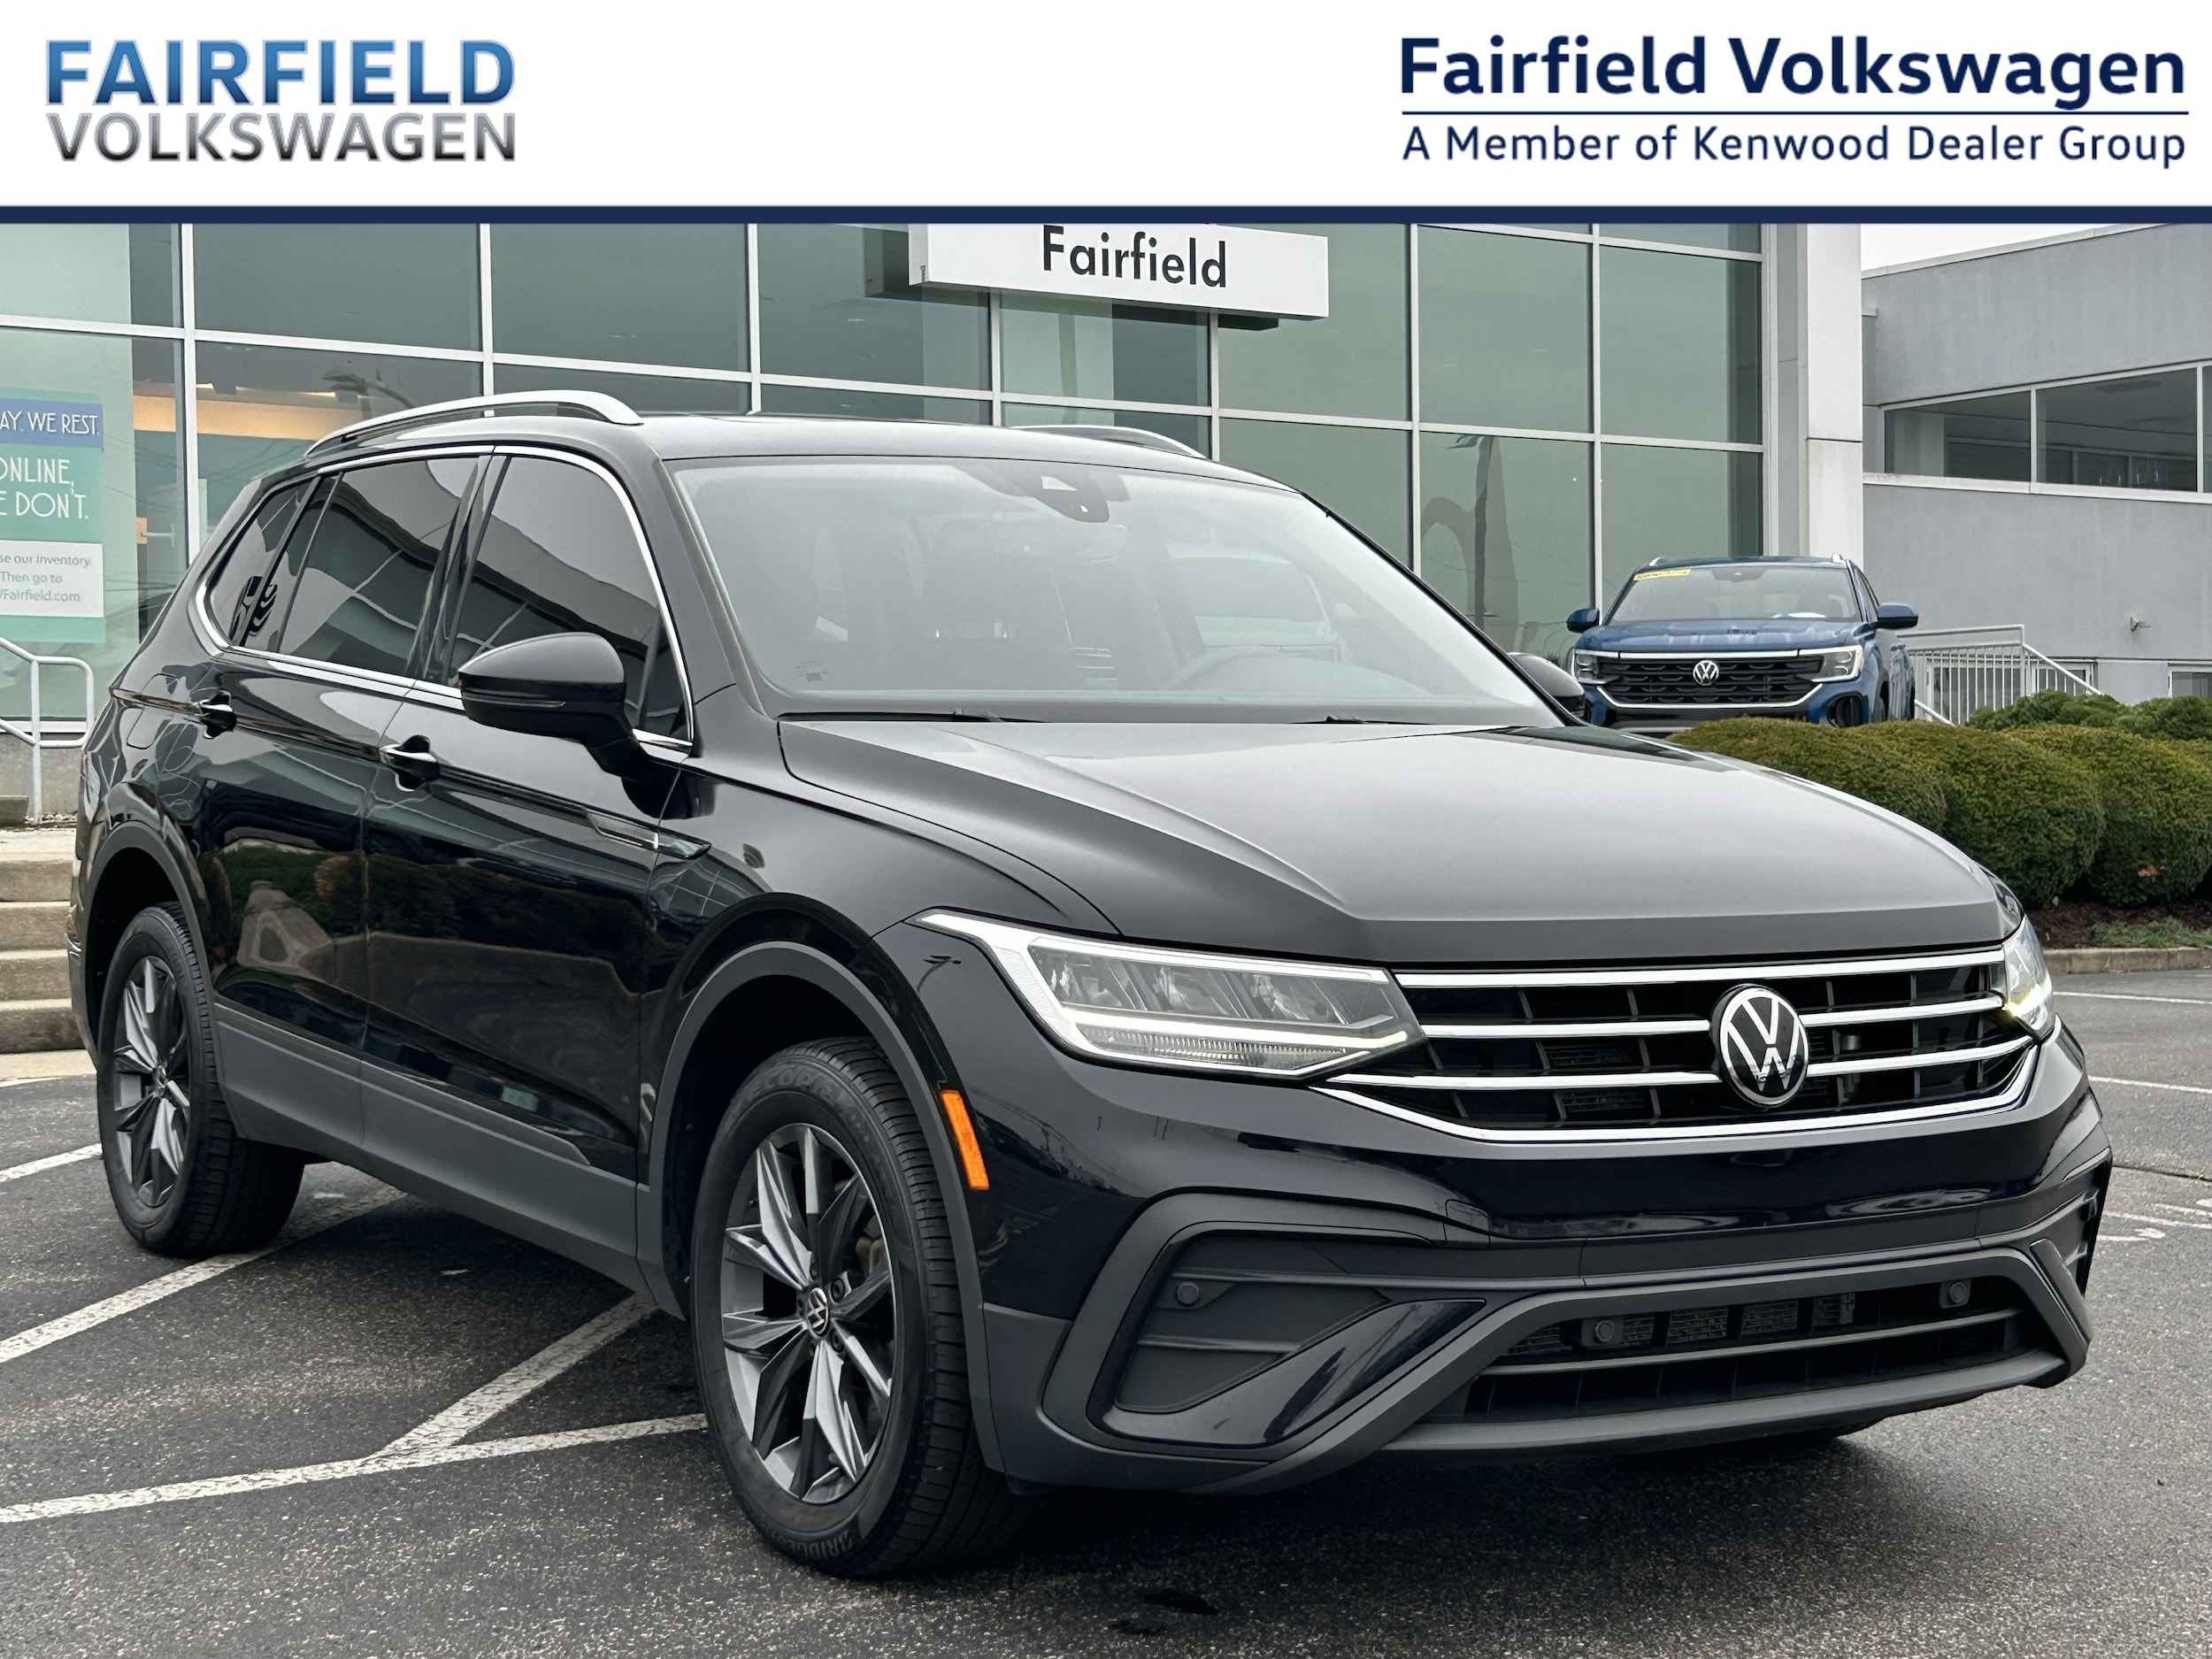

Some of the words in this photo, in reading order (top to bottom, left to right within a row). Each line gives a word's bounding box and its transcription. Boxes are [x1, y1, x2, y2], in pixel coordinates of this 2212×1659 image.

[1043, 224, 1226, 288] Fairfield
[27, 411, 57, 433] WE
[61, 413, 100, 436] REST.
[15, 488, 89, 519] DON'T.
[14, 555, 34, 565] our
[36, 554, 93, 569] inventory.
[33, 573, 48, 586] go
[50, 573, 63, 584] to
[1694, 660, 1718, 686] VW
[1722, 990, 1807, 1102] VW
